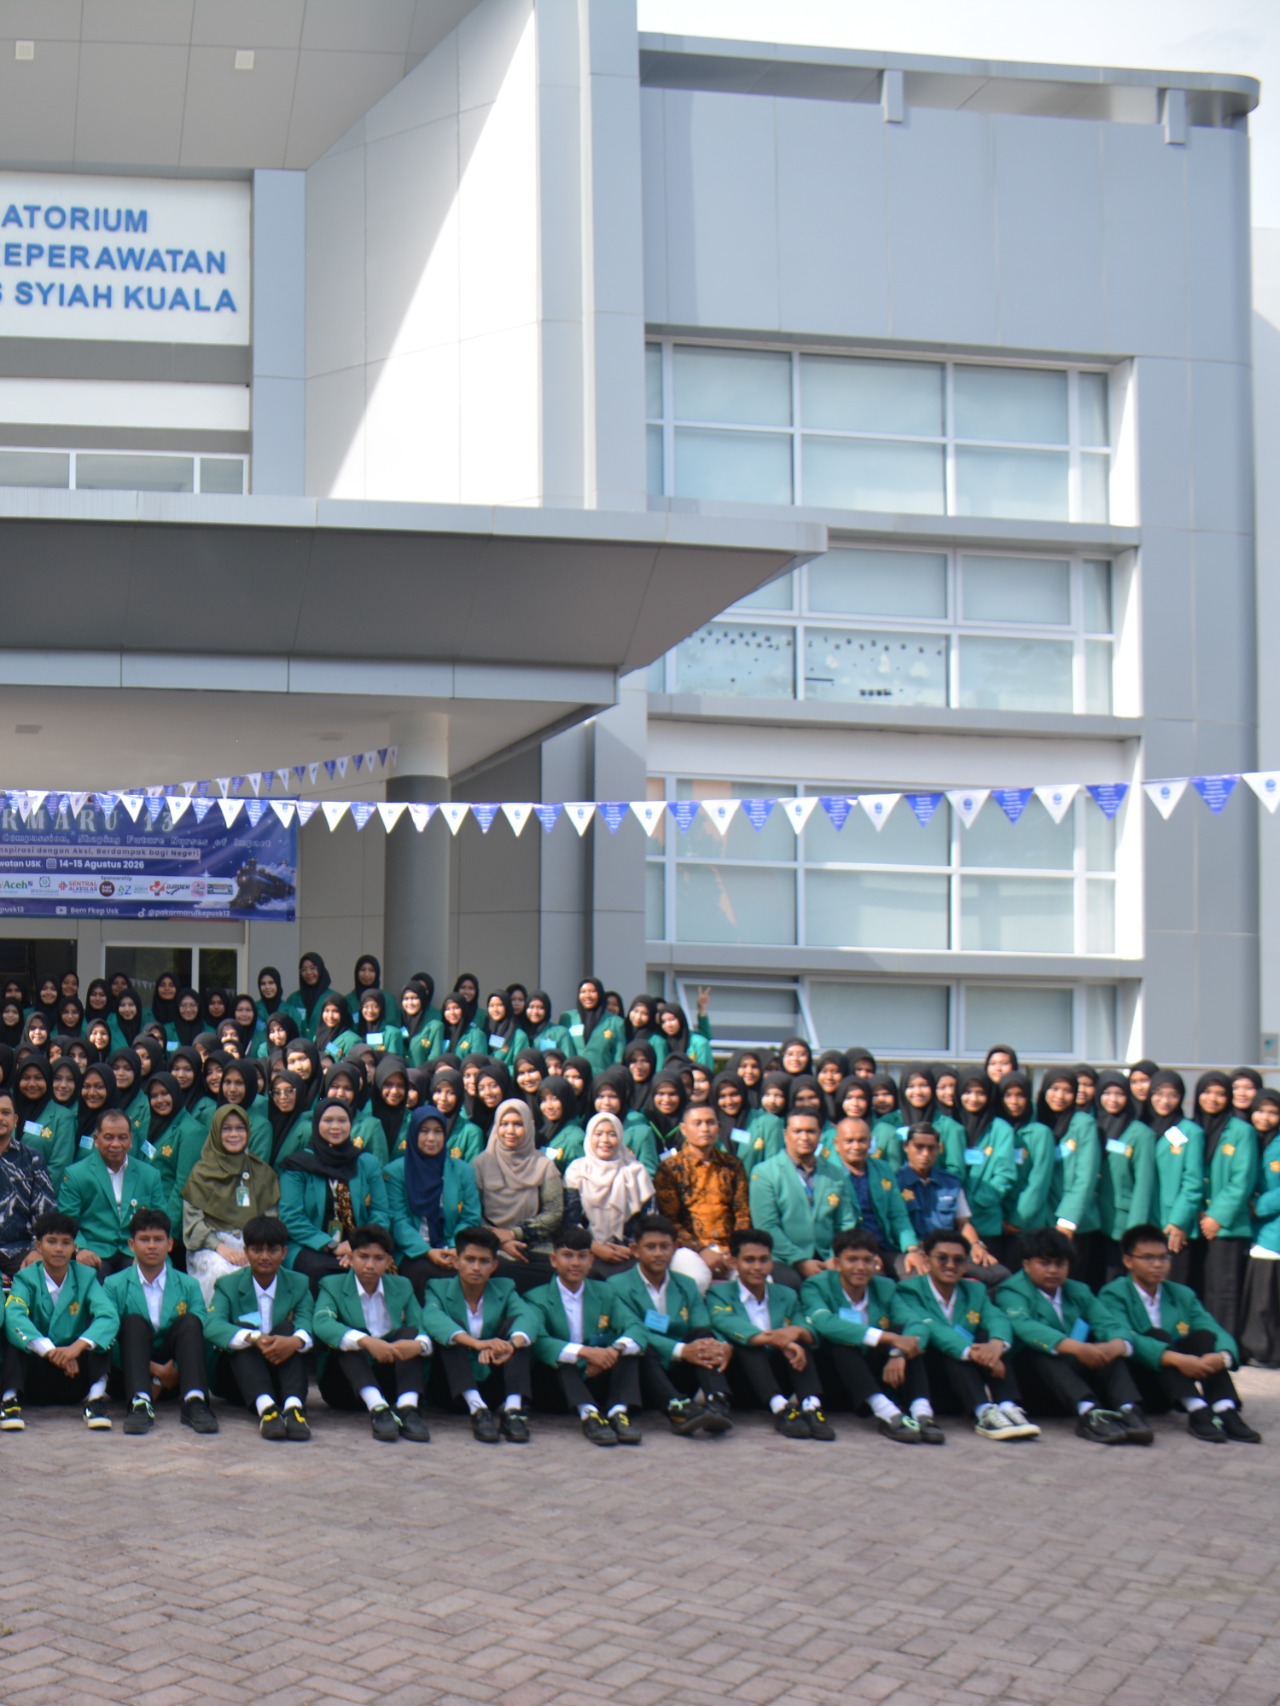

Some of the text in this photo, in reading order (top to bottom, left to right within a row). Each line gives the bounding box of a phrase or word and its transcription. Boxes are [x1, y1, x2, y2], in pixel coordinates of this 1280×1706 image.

[14, 279, 113, 309] SYIAH
[123, 285, 238, 313] KUALA
[77, 834, 121, 844] Shaping
[126, 835, 165, 844] Future
[170, 837, 208, 846] Nurses
[214, 837, 227, 847] of
[234, 838, 272, 848] Impact
[37, 848, 70, 856] dengan
[96, 849, 146, 857] Berdampak
[149, 849, 169, 857] bagi
[25, 860, 42, 868] USK
[59, 859, 145, 870] 14-15 Agustus 2026
[3, 880, 28, 889] Aceh
[88, 907, 104, 915] Fkep
